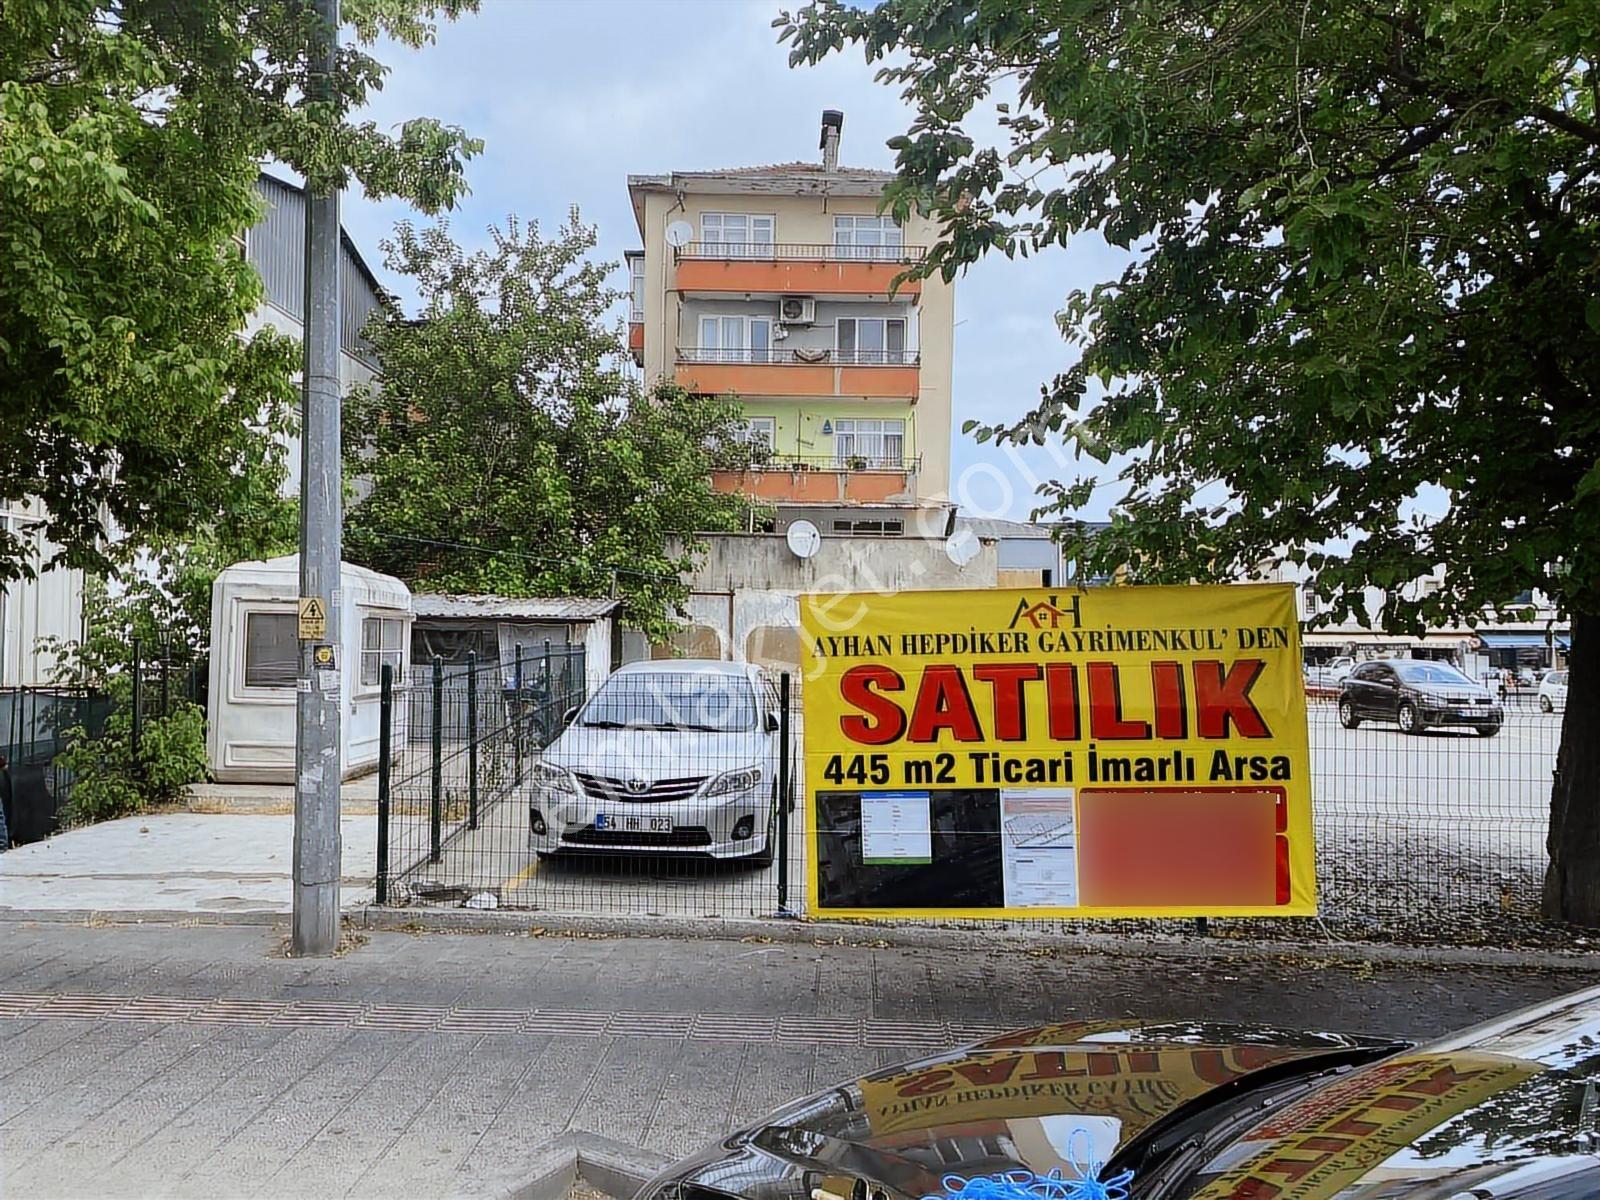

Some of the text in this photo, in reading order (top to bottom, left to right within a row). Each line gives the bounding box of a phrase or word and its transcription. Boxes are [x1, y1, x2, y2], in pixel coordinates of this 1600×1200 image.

[812, 635, 892, 657] AYHAN
[902, 626, 1029, 655] HEPDİKER
[1237, 627, 1288, 649] DEN
[840, 660, 1273, 745] SATILIK
[824, 743, 1291, 784] 445 m2 Ticari İmarlı Arsa
[604, 816, 616, 830] 54
[626, 817, 639, 830] HH
